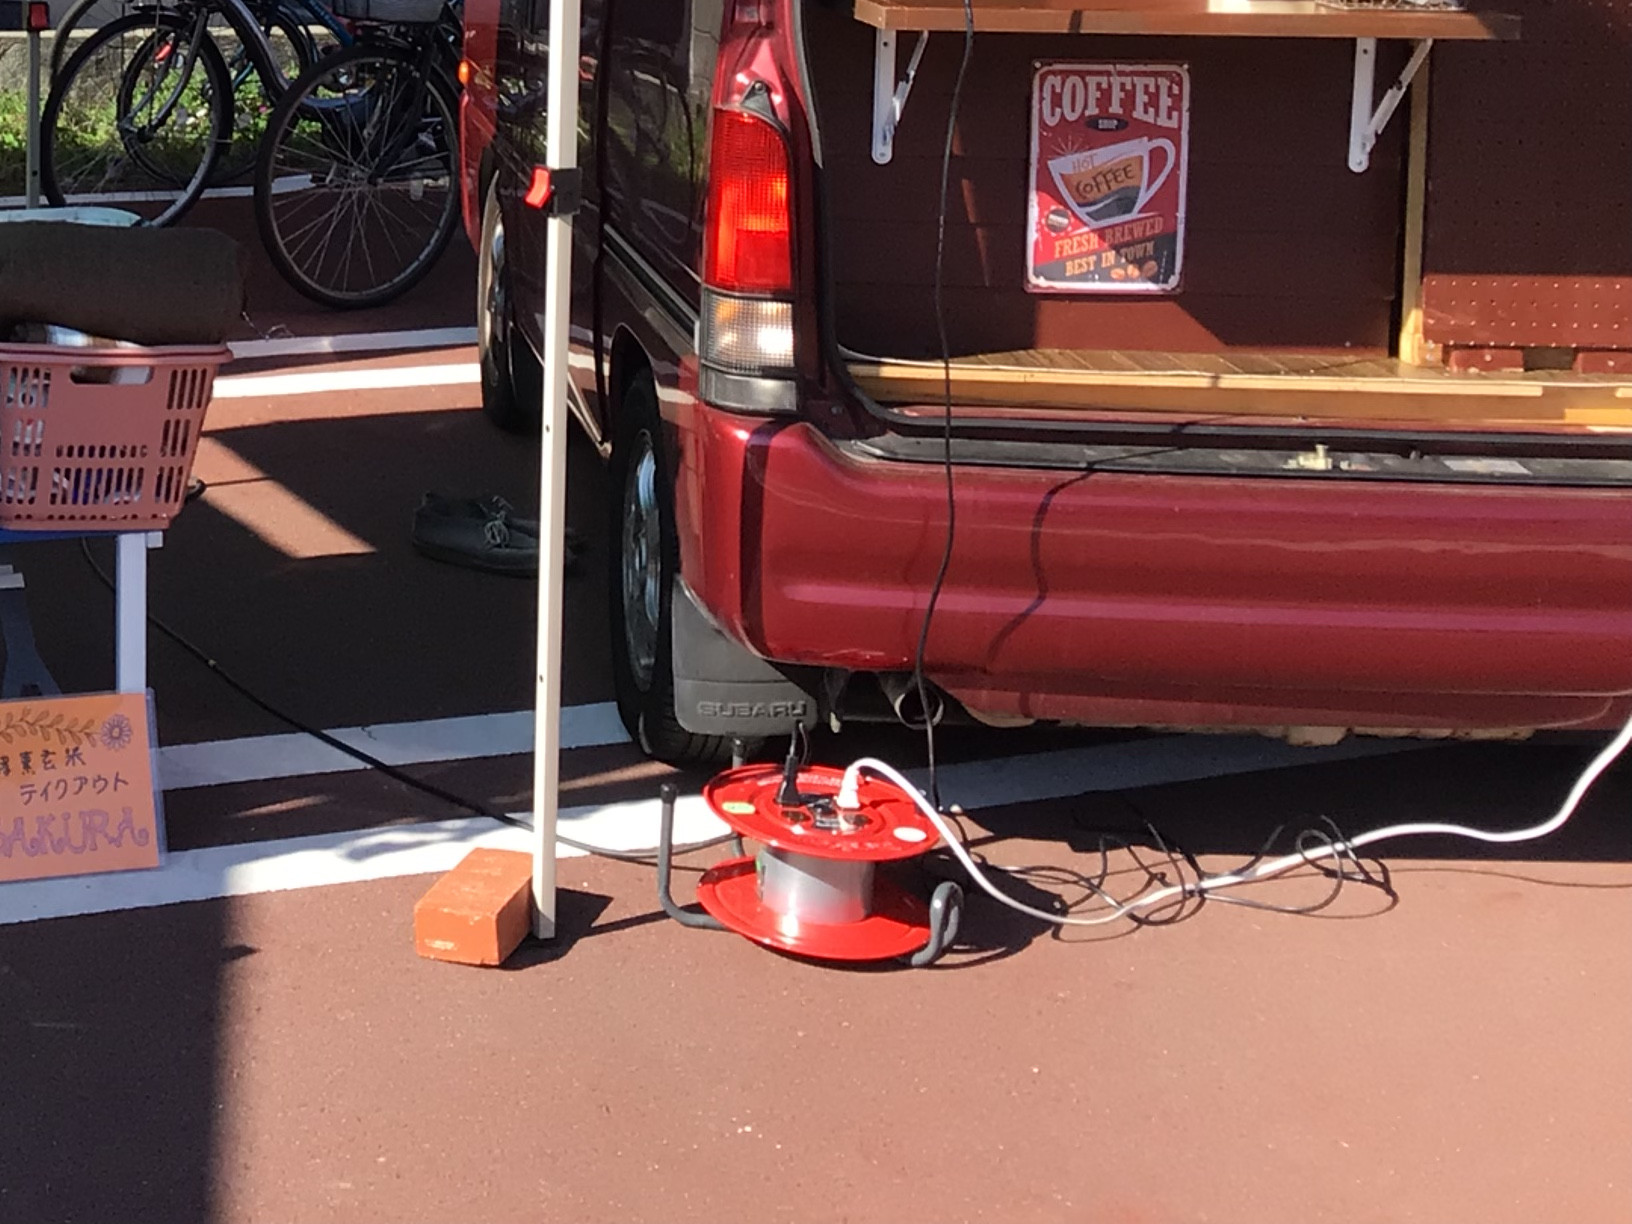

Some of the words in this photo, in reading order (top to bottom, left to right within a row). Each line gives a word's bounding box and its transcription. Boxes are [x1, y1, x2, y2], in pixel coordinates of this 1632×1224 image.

[1041, 73, 1180, 129] COFFEE
[1054, 231, 1100, 259] FRESH
[1104, 216, 1165, 246] BREWED
[1065, 255, 1096, 277] BEST
[1101, 250, 1116, 268] IN
[1120, 241, 1155, 263] TOWN
[697, 700, 807, 718] SUBARU
[20, 772, 130, 806] テイクアウト
